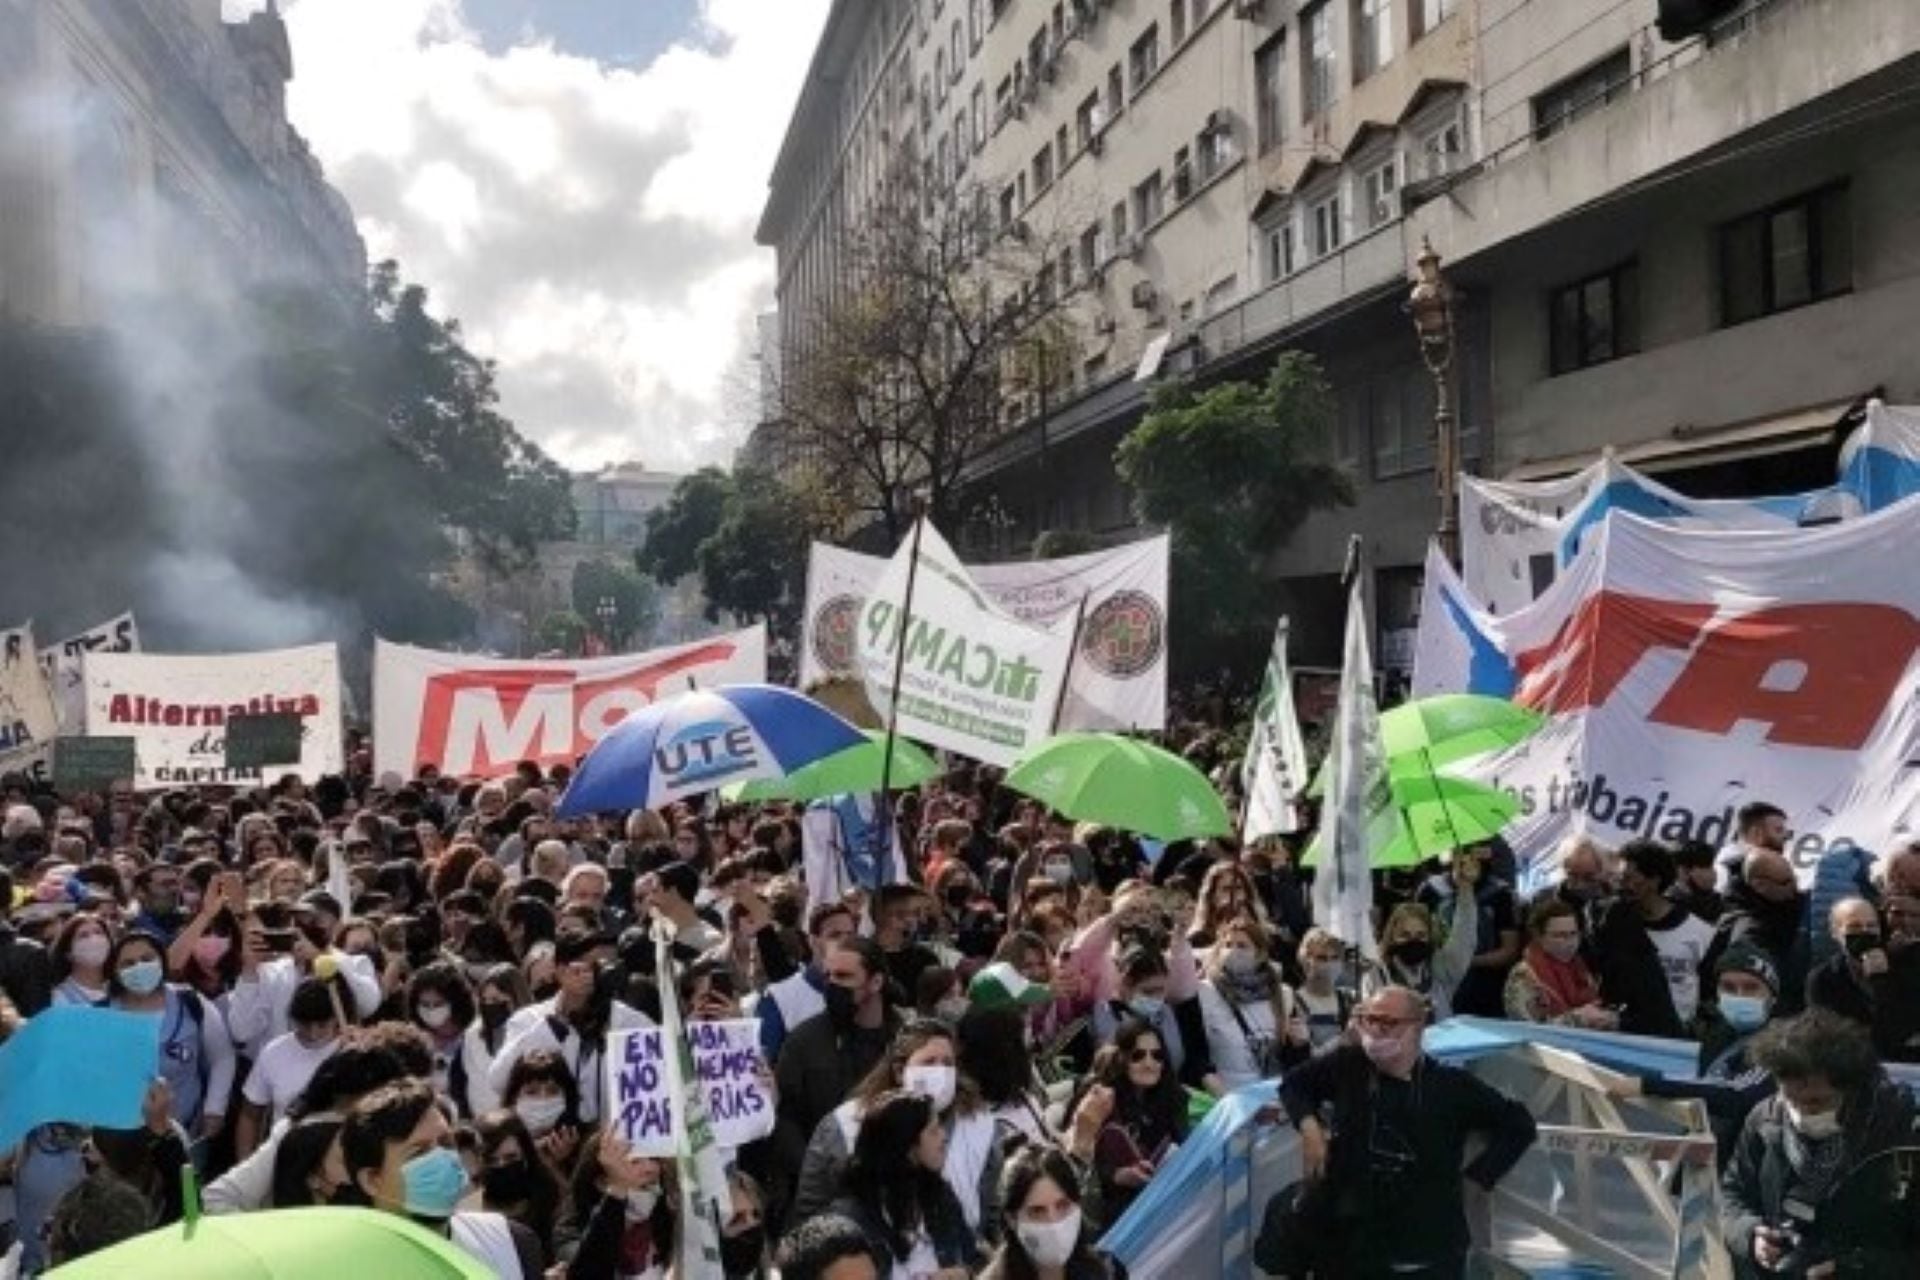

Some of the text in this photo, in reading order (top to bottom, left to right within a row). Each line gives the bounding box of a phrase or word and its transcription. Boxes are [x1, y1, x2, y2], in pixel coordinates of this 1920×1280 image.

[656, 725, 755, 775] UTE
[625, 1024, 730, 1064] EN ABA
[619, 1063, 658, 1103] NO
